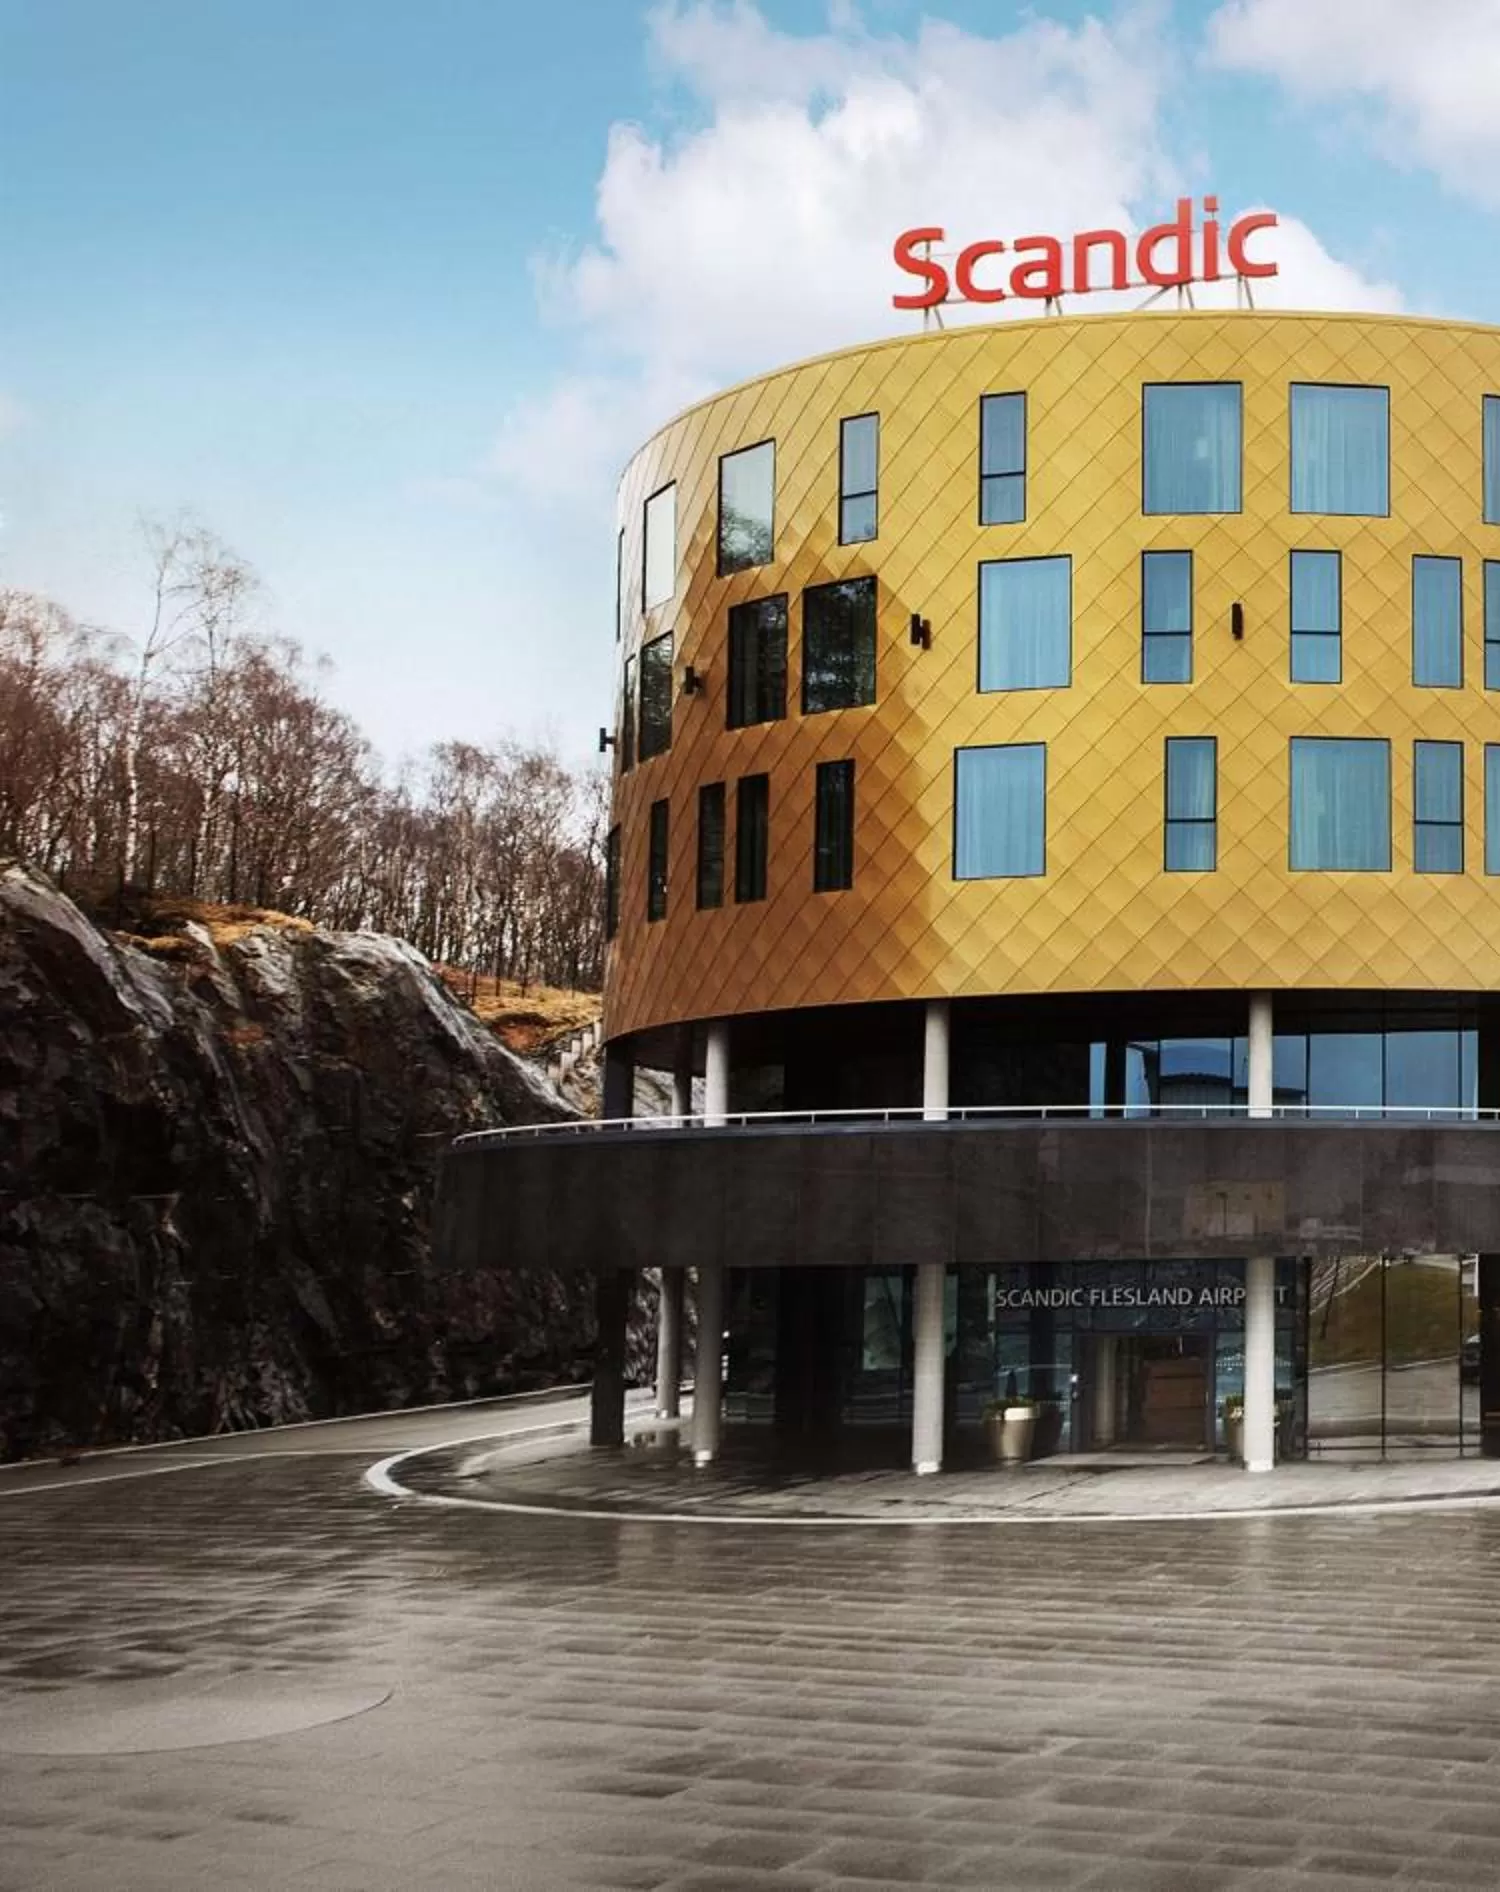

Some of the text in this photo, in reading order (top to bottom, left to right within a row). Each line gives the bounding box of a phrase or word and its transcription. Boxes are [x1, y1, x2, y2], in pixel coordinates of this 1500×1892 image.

[892, 195, 1279, 309] Scandic
[995, 1286, 1288, 1308] SCANDIC FLESLAND AIRPT
